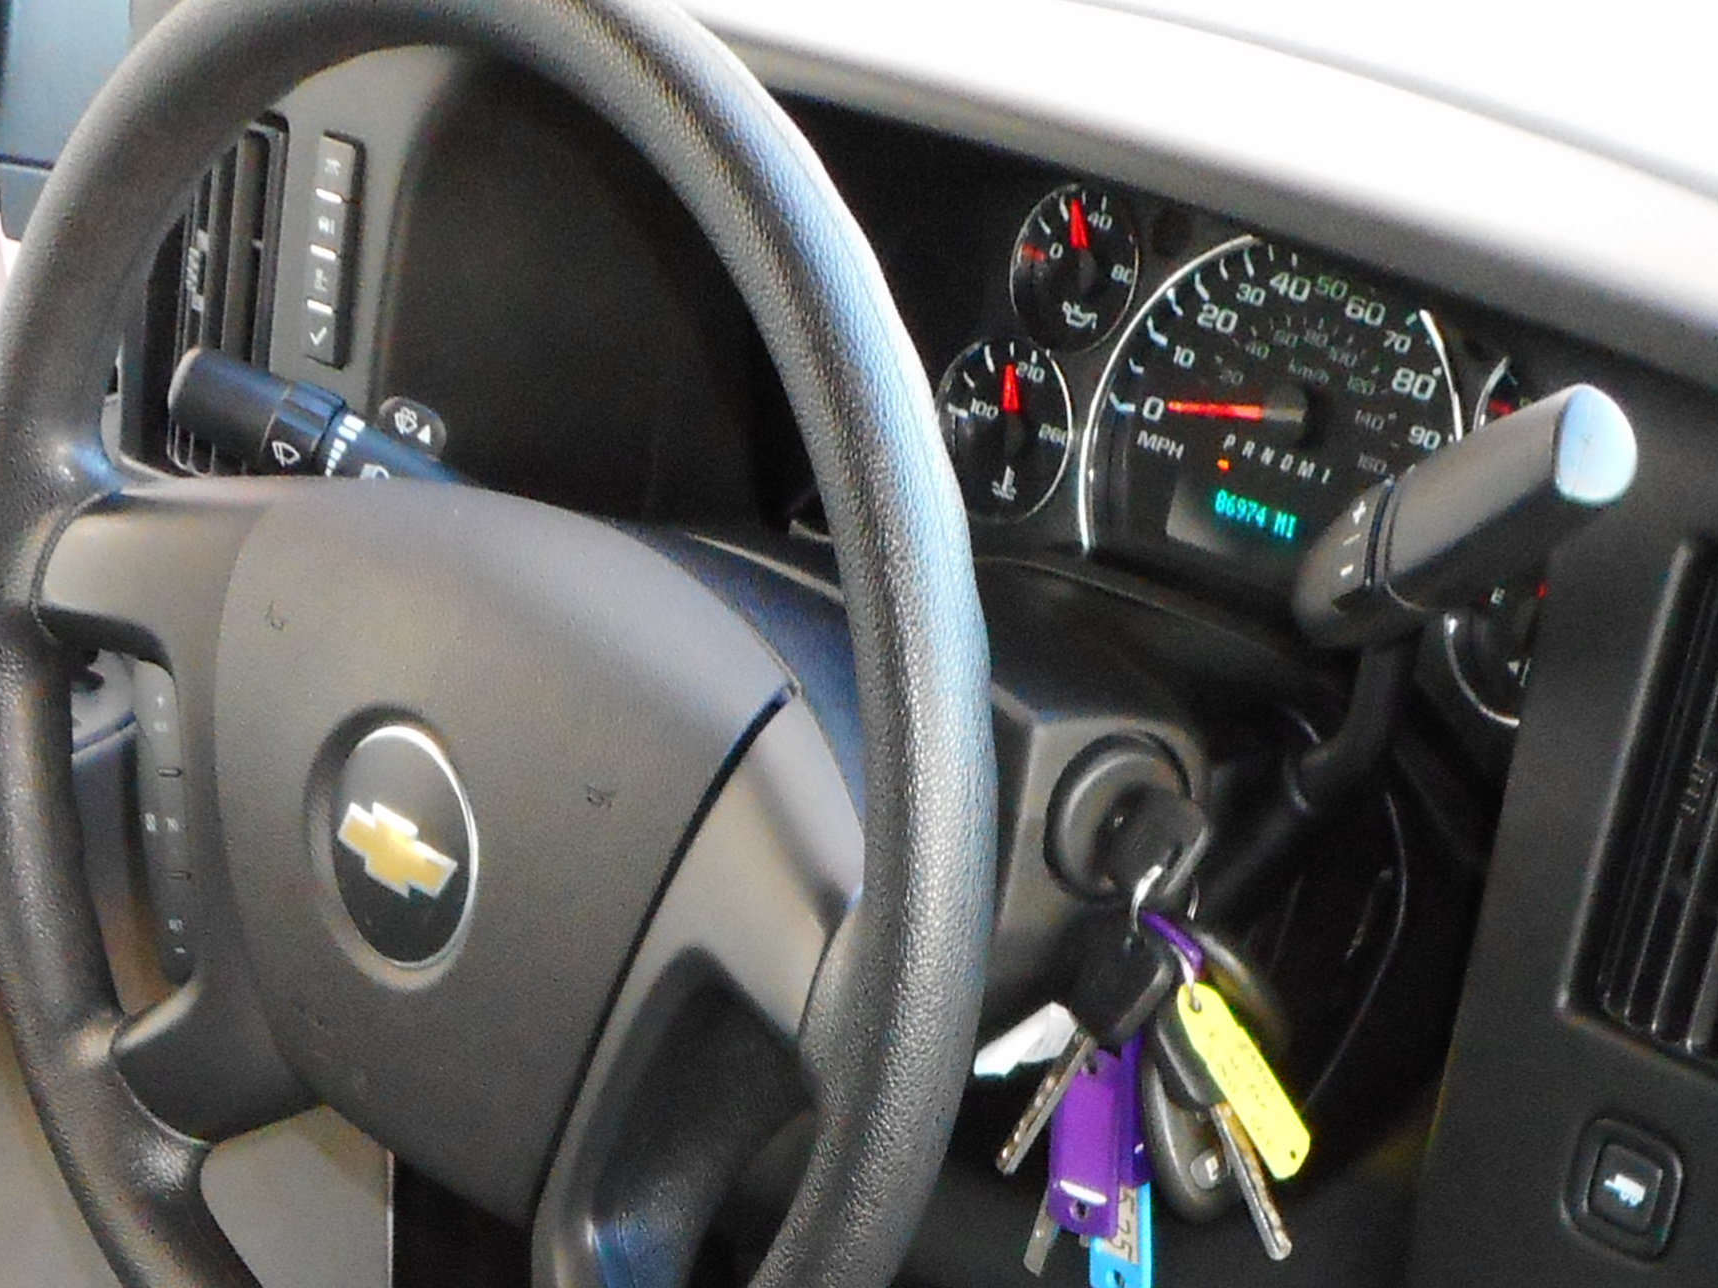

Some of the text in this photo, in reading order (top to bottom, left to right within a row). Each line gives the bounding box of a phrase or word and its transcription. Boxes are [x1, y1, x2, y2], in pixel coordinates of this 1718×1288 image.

[1087, 211, 1113, 231] 40
[1049, 243, 1063, 259] 0
[1236, 283, 1266, 306] 30
[1269, 272, 1312, 303] 40
[1314, 275, 1348, 300] 50
[1197, 302, 1238, 334] 20
[1345, 296, 1386, 327] 60
[1384, 330, 1411, 354] 70
[1173, 346, 1195, 369] 10
[1015, 361, 1045, 384] 210
[1392, 367, 1437, 401] 80
[970, 398, 999, 420] 100
[1142, 396, 1164, 422] 0
[1137, 430, 1185, 459] MPH
[1408, 425, 1441, 450] 90
[1274, 511, 1297, 540] MI
